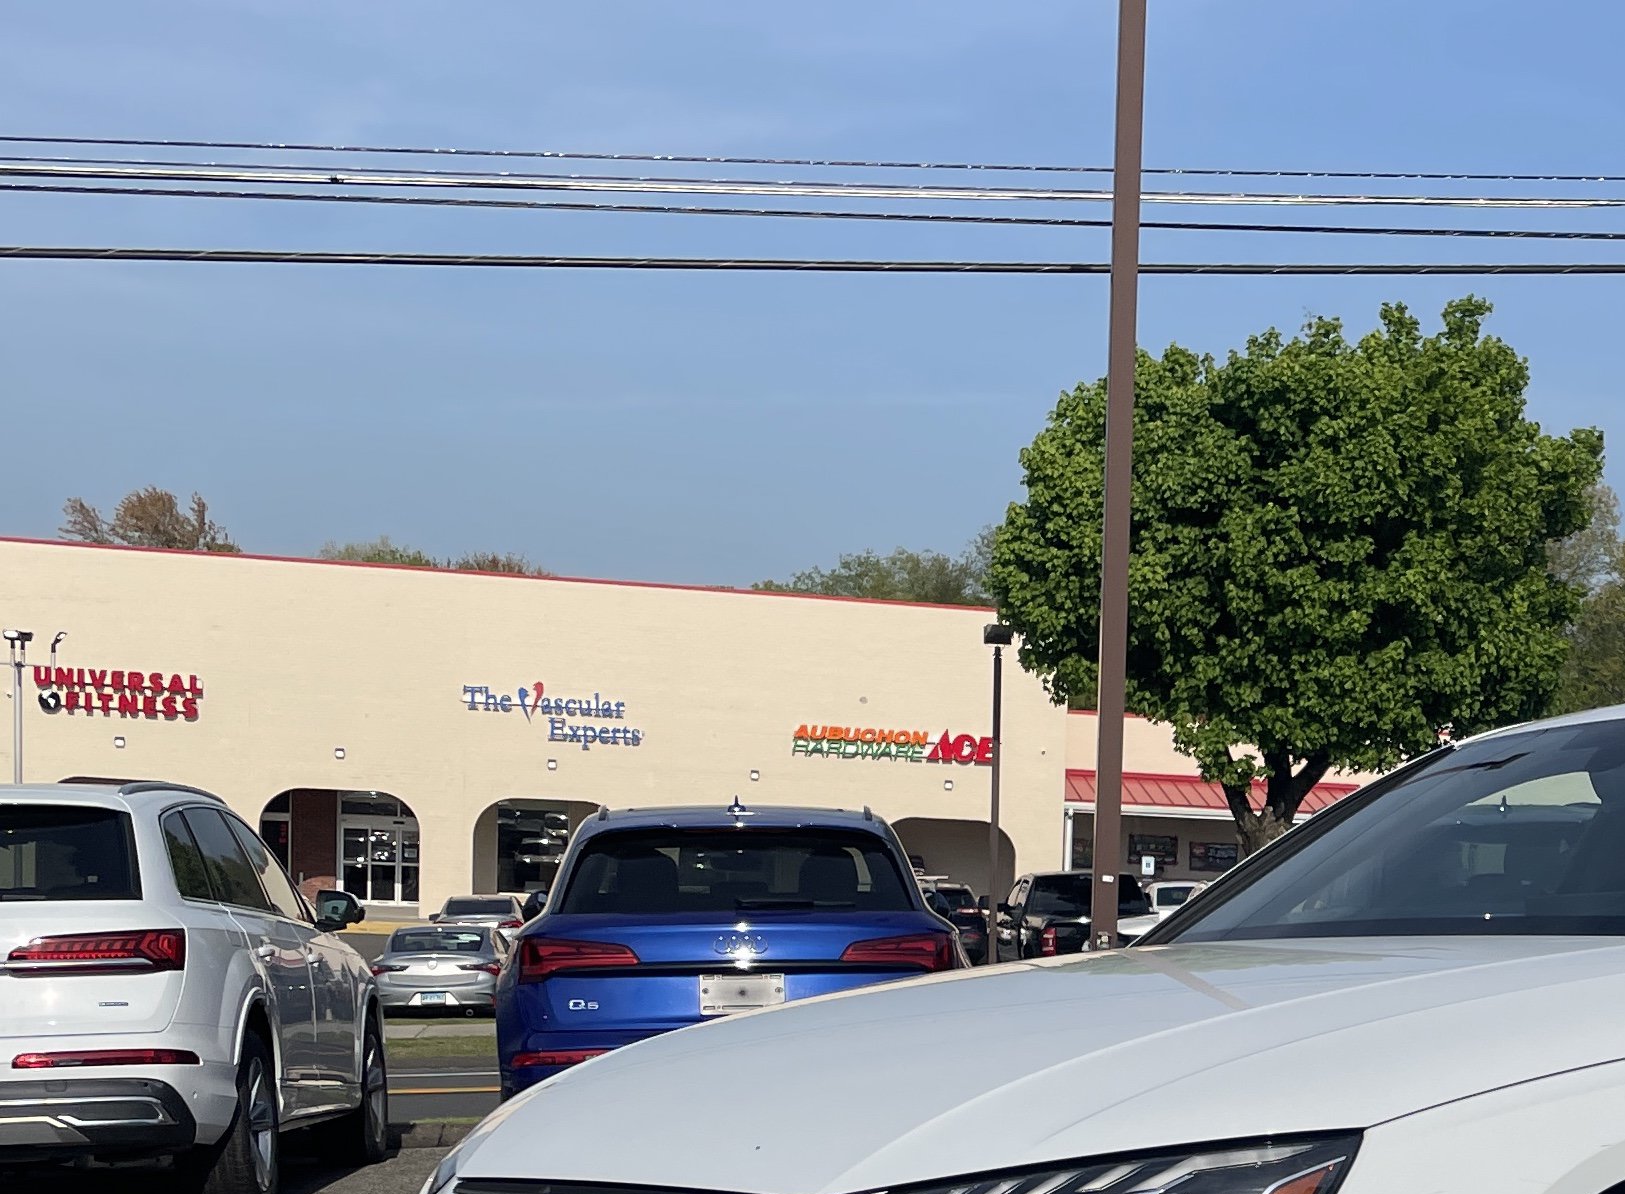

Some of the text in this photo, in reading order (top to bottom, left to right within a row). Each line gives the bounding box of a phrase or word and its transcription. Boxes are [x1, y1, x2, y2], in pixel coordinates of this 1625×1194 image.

[33, 666, 203, 698] UNIVERSAL
[65, 691, 199, 722] FITNESS
[463, 681, 625, 724] The Vascular
[548, 717, 642, 750] Experts
[793, 725, 993, 764] AUBUCHON ACE
[792, 738, 925, 763] HARDWARE
